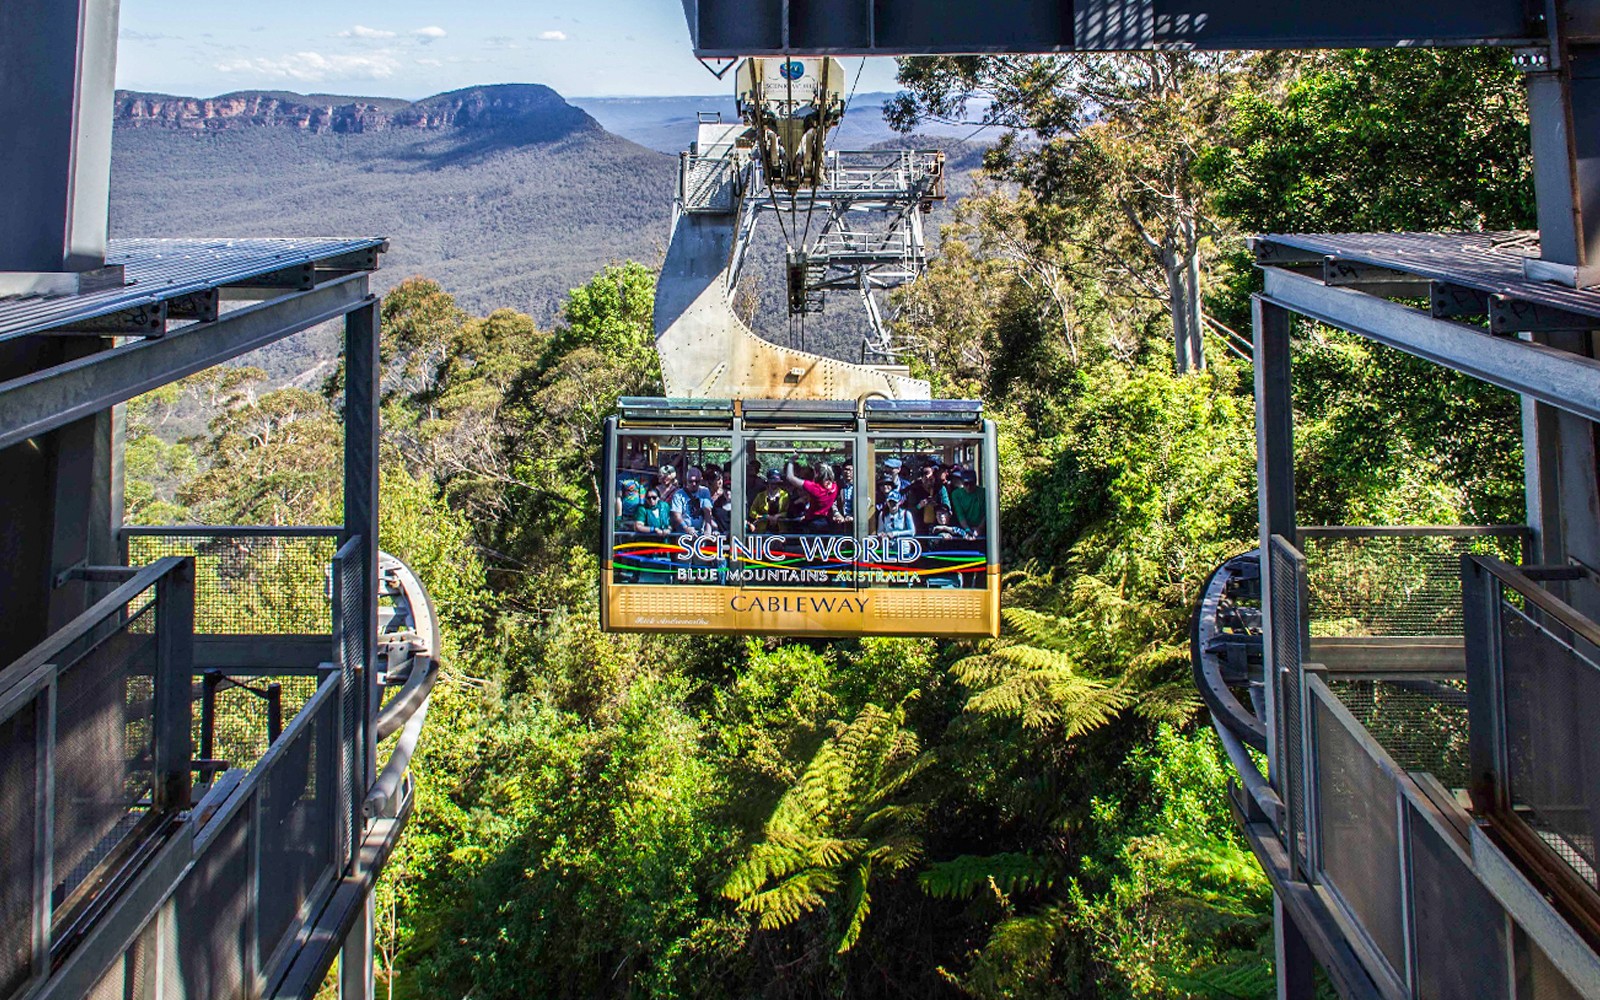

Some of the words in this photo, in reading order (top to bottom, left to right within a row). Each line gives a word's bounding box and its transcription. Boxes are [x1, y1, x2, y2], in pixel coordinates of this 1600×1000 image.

[677, 534, 786, 561] SCENIC
[799, 536, 922, 563] WORLD
[677, 568, 718, 581] BLUE
[726, 569, 829, 582] MOUNTAINS
[834, 570, 921, 583] AUSTRALIA
[730, 595, 870, 613] CABLEWAY
